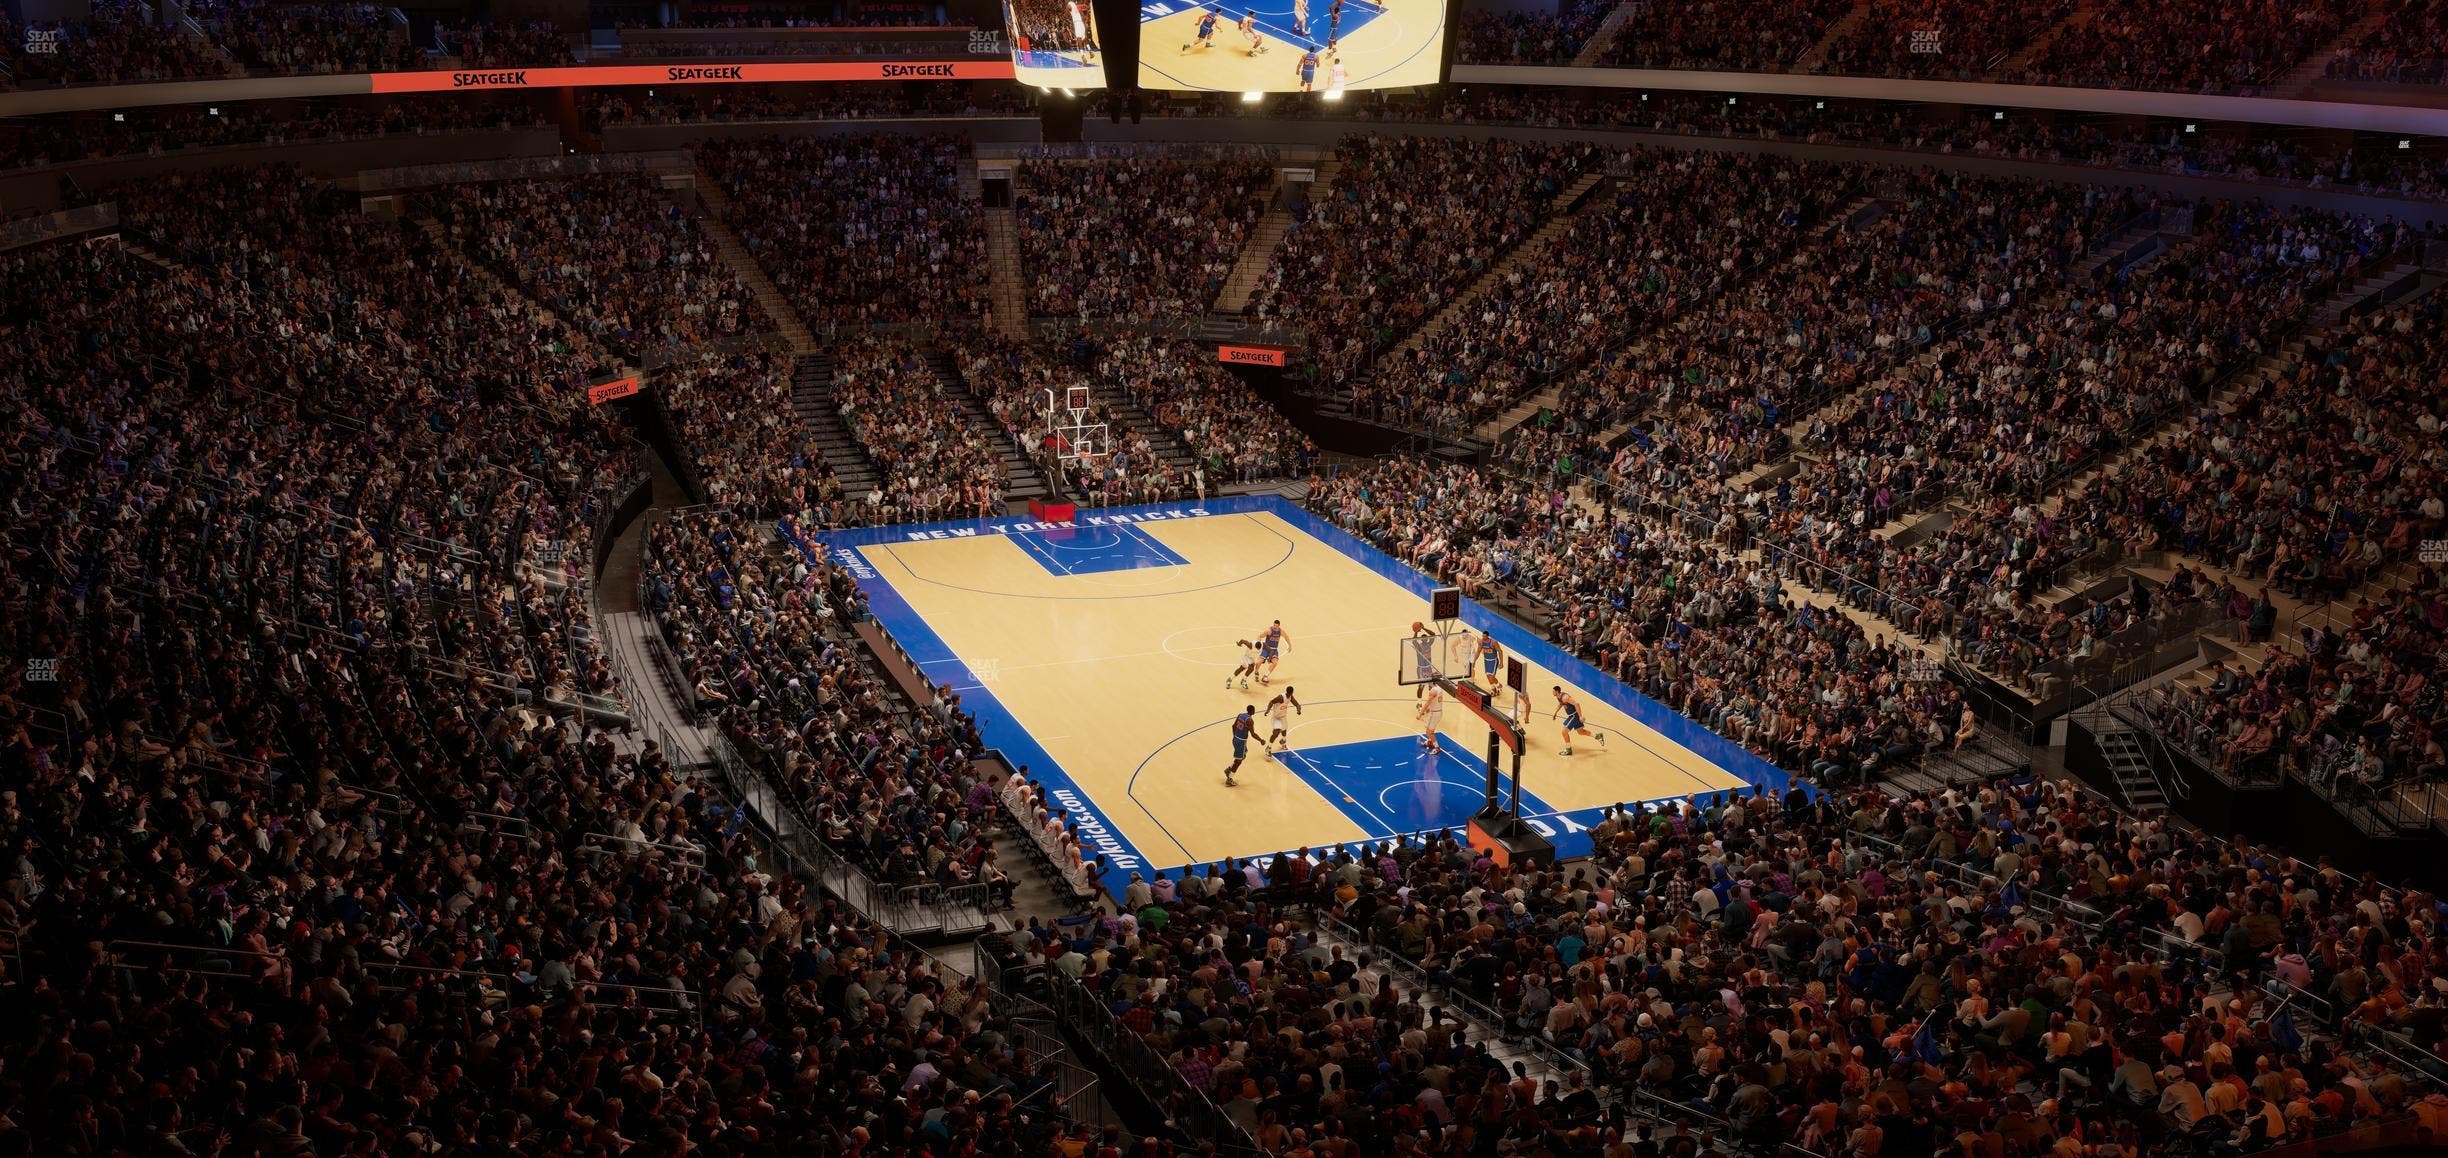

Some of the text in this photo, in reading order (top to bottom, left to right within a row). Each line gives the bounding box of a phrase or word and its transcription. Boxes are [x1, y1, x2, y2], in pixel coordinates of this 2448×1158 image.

[668, 66, 743, 81] SEATGEEK
[882, 63, 955, 77] SEATGEEK
[453, 71, 528, 87] SEATGEEK
[1230, 351, 1274, 363] SEATGEEK
[596, 383, 630, 401] SEATGEEK
[907, 508, 1211, 541] NEW YORK KNICKS
[1052, 789, 1140, 869] nyknicks.com
